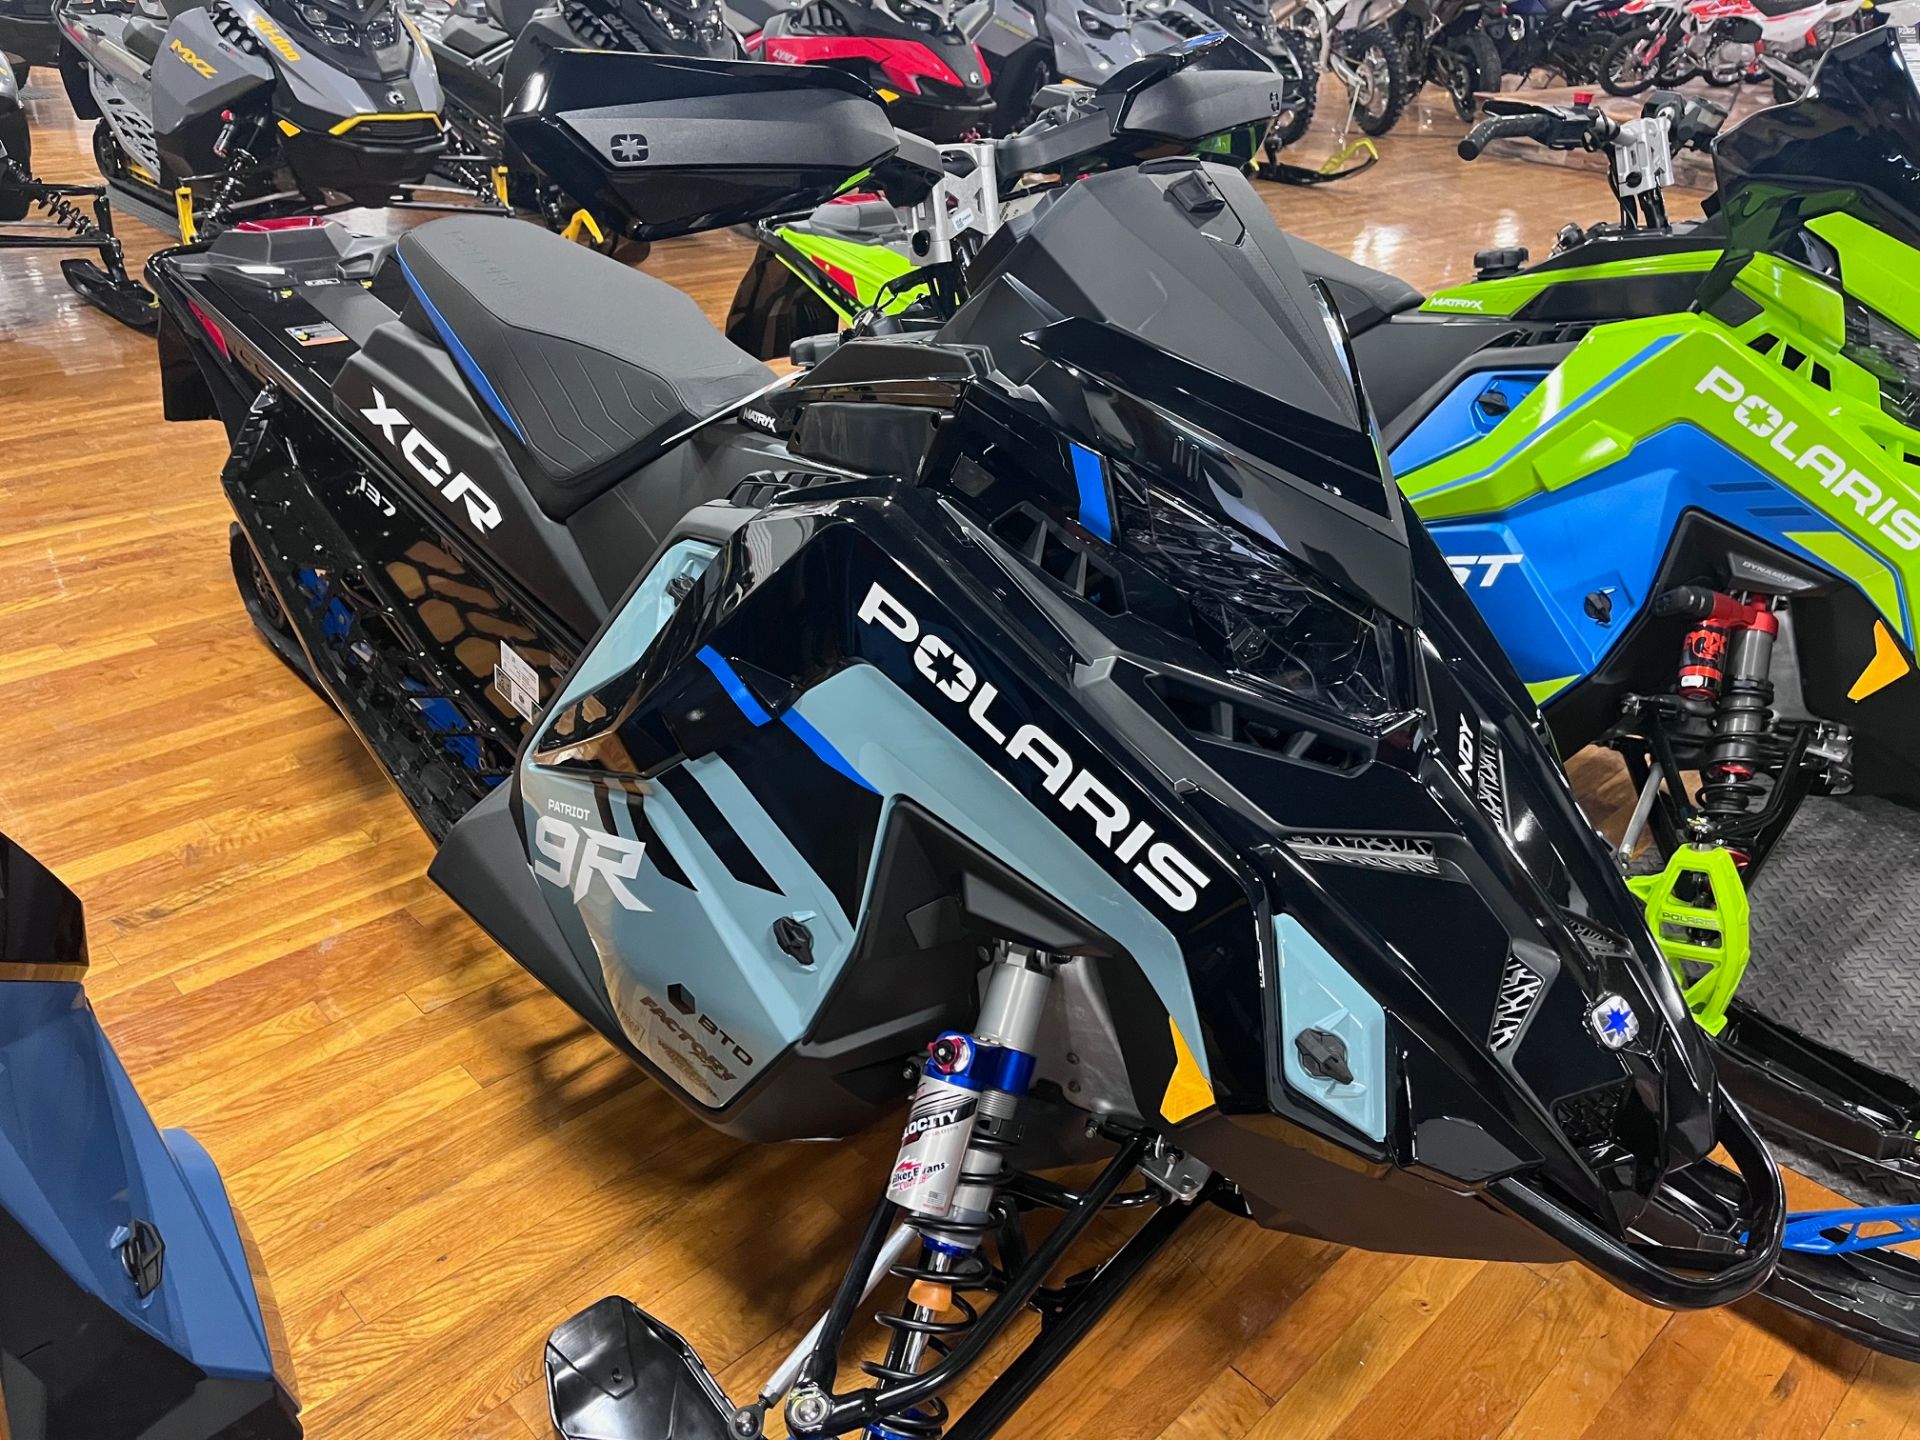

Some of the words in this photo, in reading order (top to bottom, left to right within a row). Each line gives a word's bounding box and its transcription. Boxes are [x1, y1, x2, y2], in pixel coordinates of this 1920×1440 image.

[169, 38, 219, 80] MXZ
[772, 48, 799, 64] LYNX
[1429, 297, 1484, 312] MATRYX
[742, 406, 777, 433] MATRYX
[359, 385, 503, 535] XCR
[1694, 365, 1920, 551] POLARIS
[359, 476, 397, 517] 137
[1742, 560, 1796, 583] DYNAMIX
[857, 582, 1211, 912] POLARIS
[1457, 712, 1474, 790] INDY
[547, 798, 591, 821] PATRIOT
[533, 815, 655, 913] 9R
